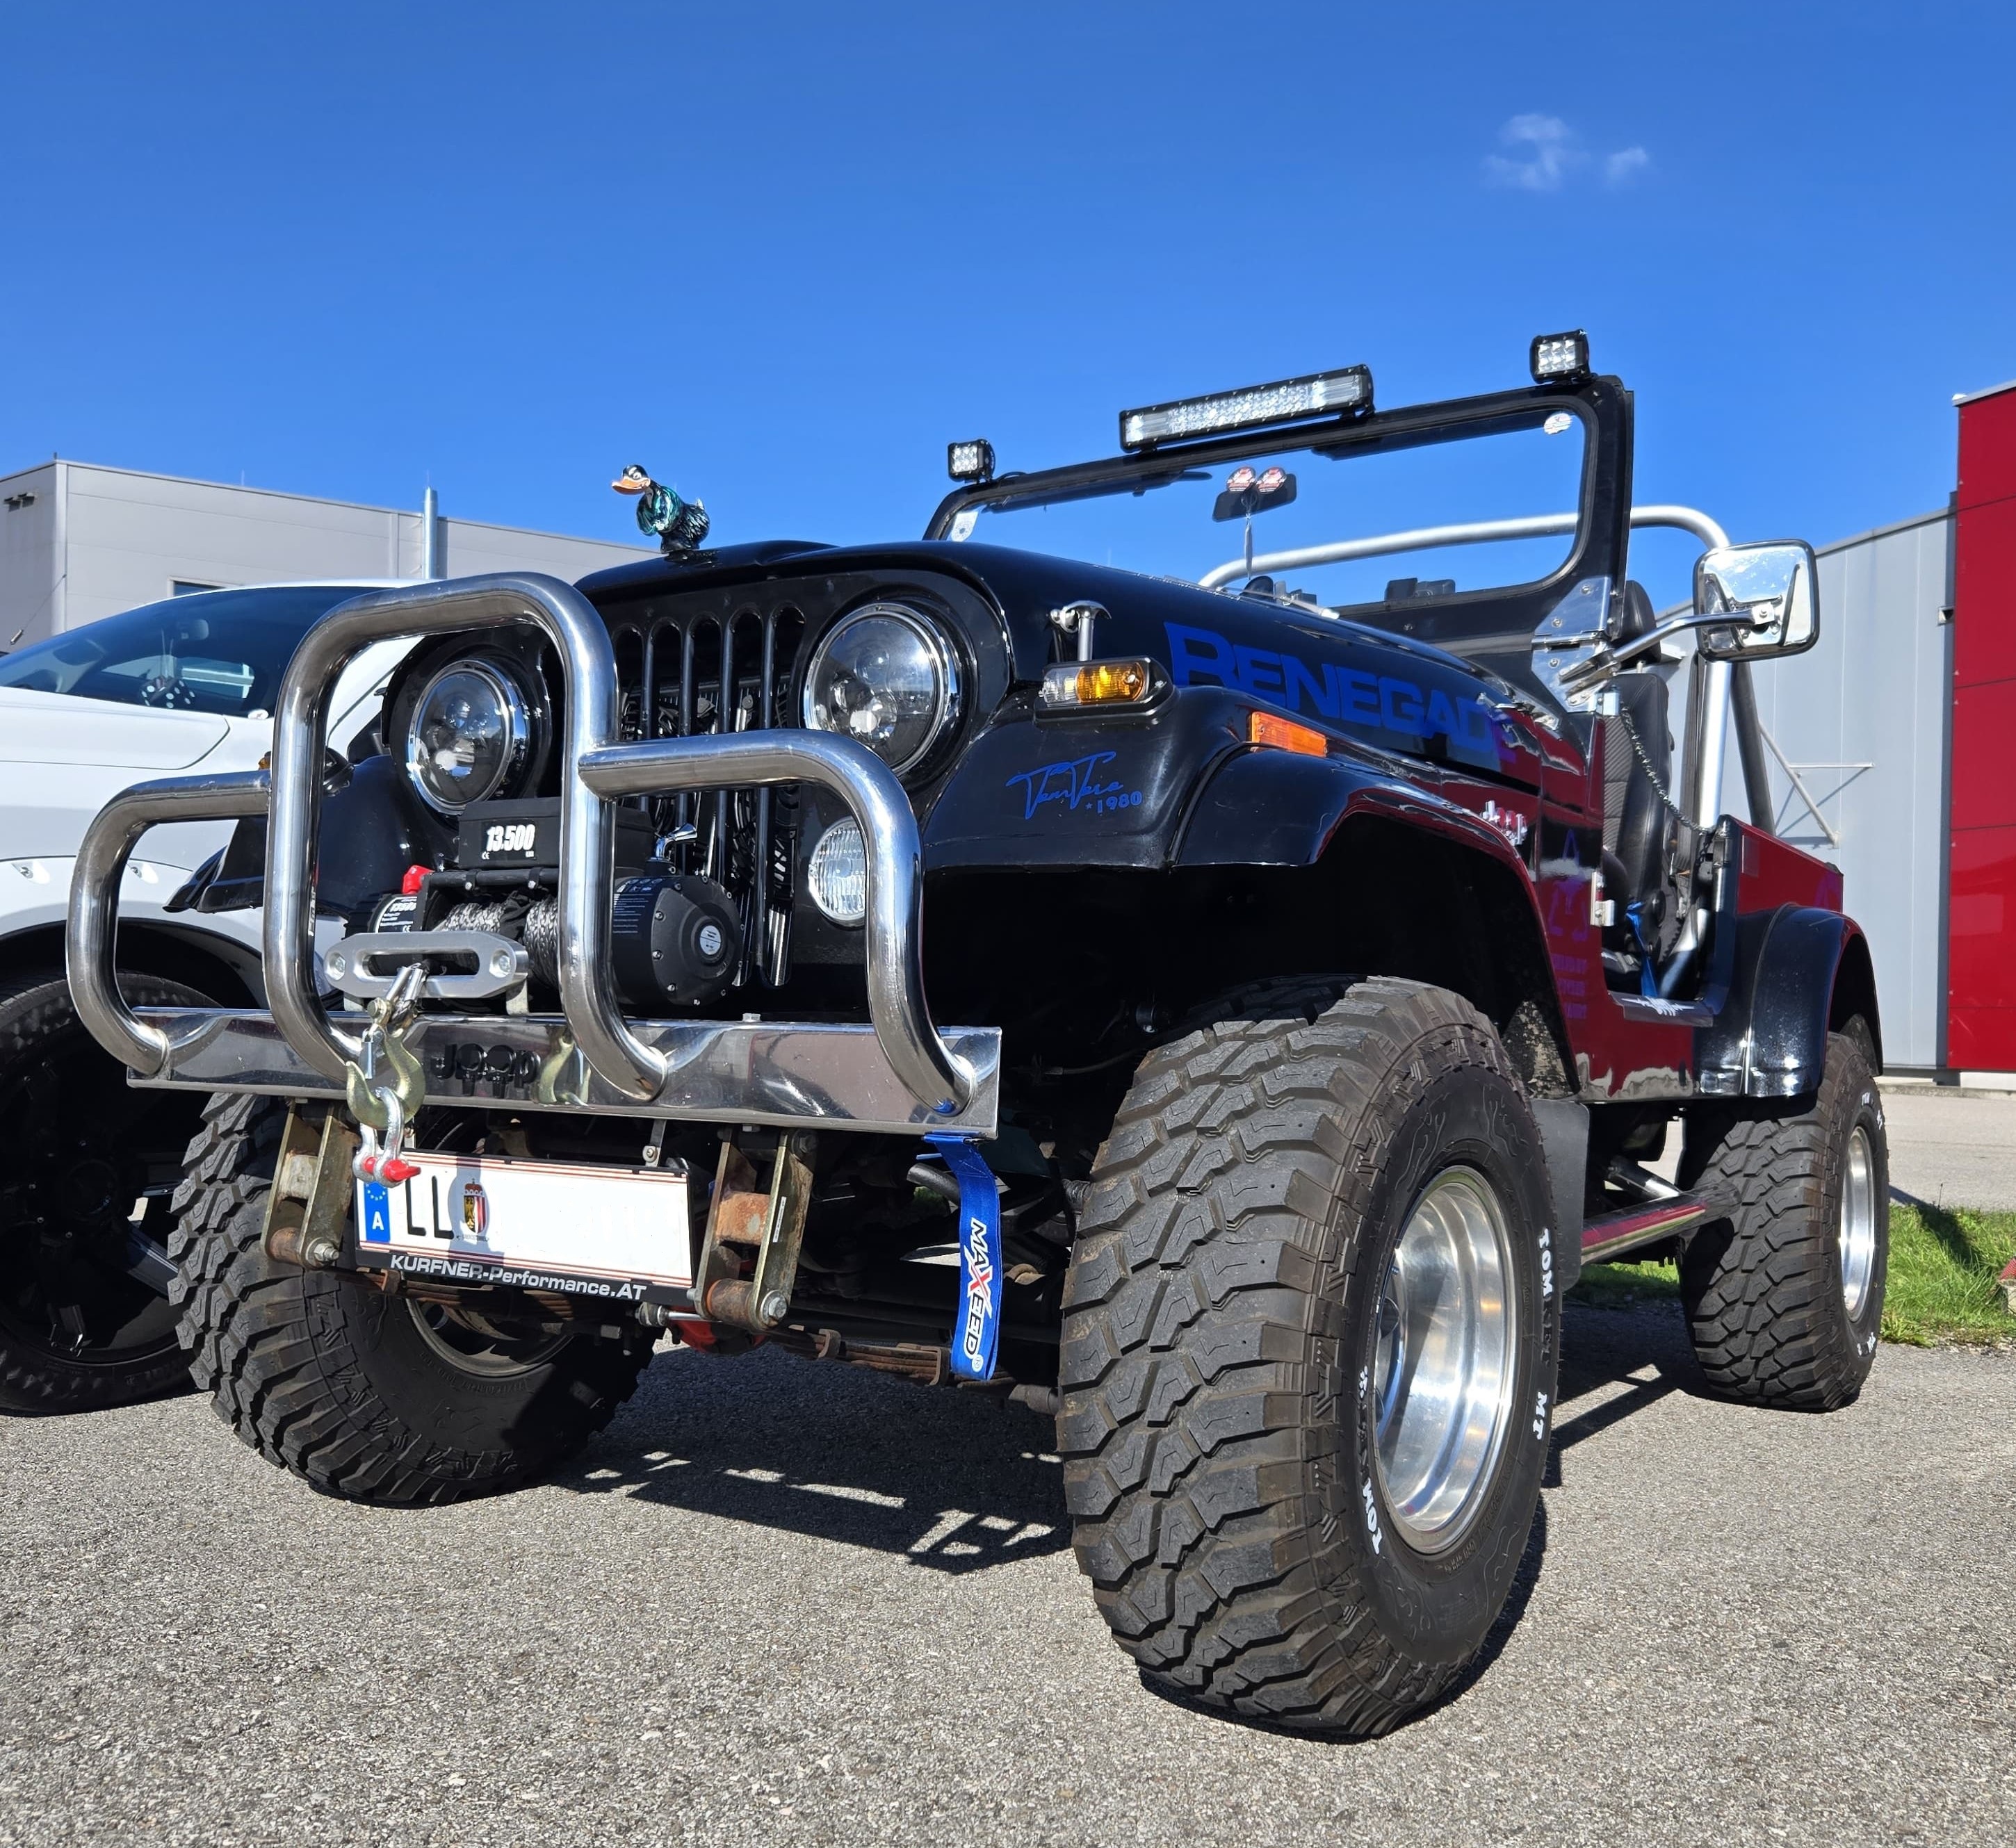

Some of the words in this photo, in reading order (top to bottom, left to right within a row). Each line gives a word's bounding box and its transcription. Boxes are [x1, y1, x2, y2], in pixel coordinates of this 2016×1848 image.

[1164, 621, 1517, 763] RENEGADE
[1096, 790, 1144, 815] 1980
[372, 1211, 384, 1230] A
[1533, 1391, 1548, 1440] MT
